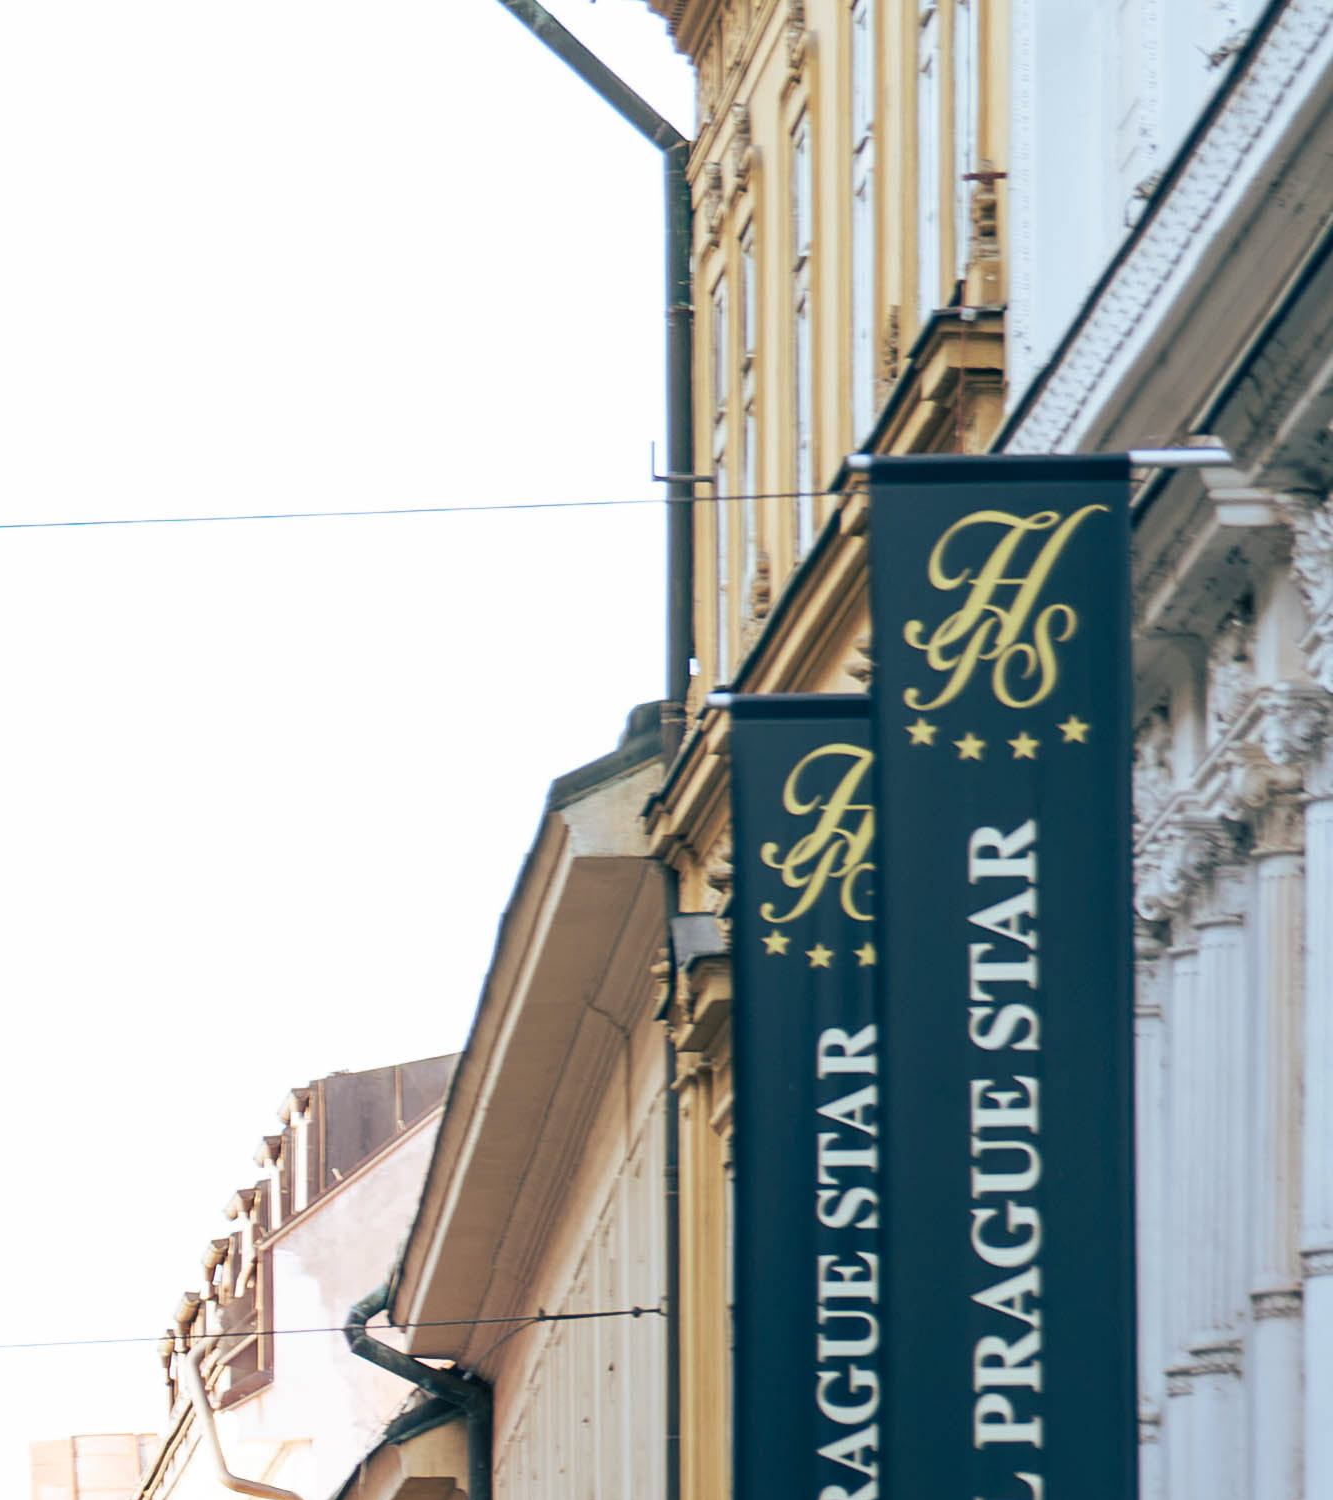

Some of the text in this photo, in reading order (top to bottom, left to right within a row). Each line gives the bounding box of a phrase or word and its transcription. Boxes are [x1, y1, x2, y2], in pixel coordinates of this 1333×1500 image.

[966, 818, 1041, 1051] STAR
[815, 1023, 880, 1230] STAR
[969, 1074, 1044, 1449] PRAGUE
